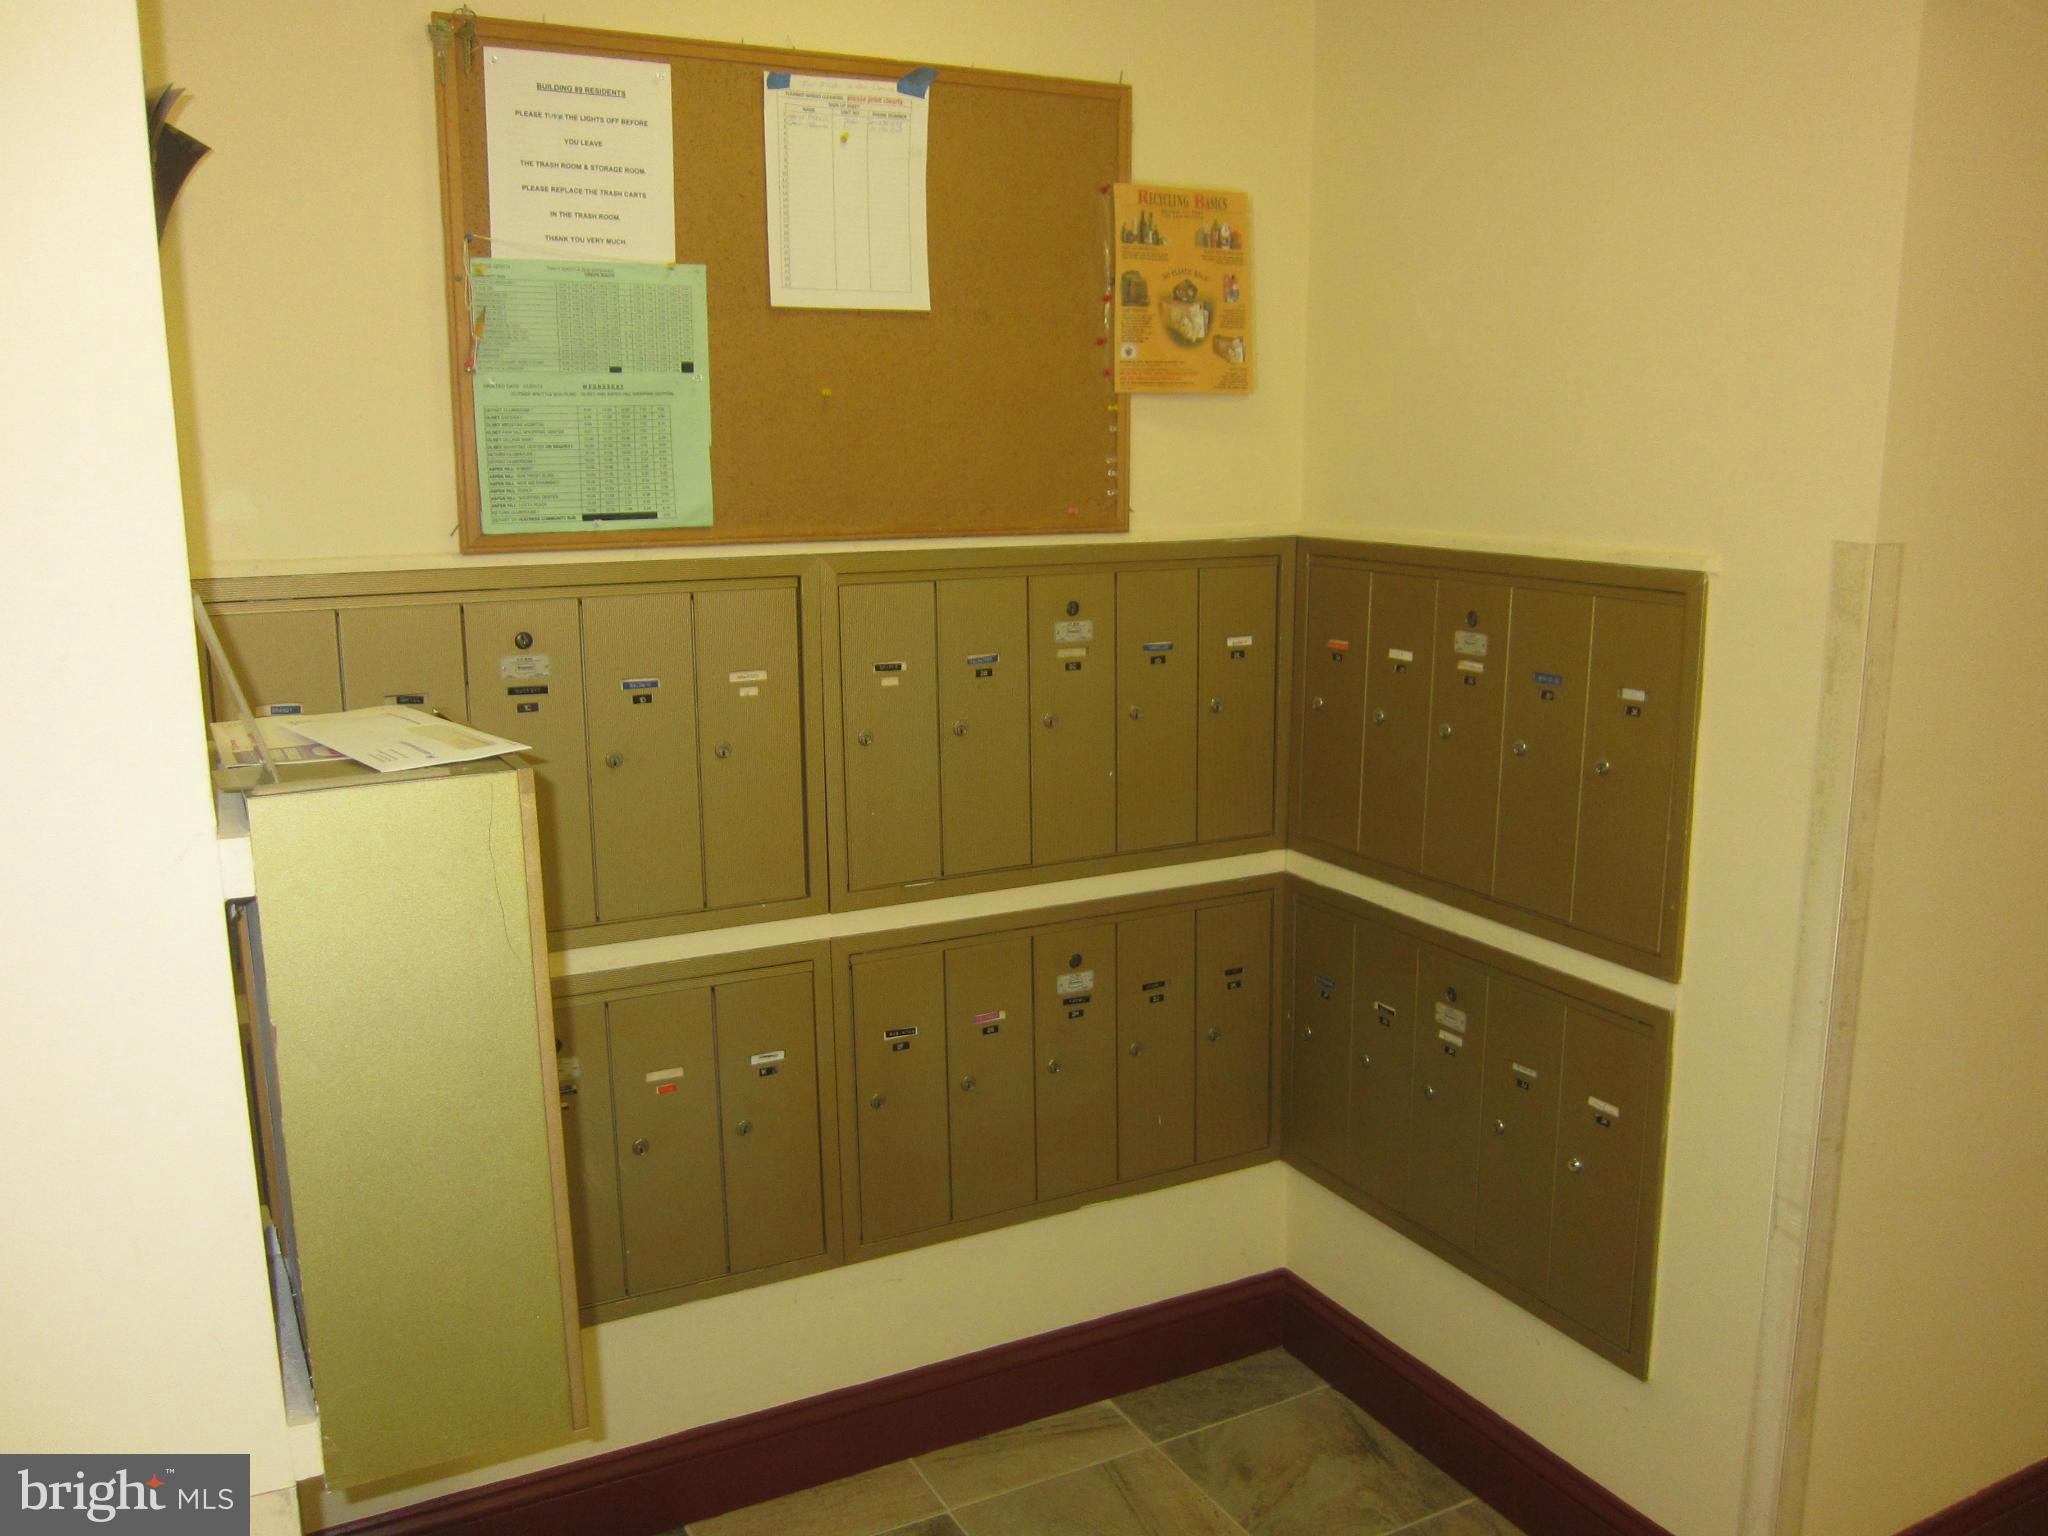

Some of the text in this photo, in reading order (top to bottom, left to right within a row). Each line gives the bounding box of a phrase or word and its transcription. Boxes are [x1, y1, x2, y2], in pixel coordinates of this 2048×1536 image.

[536, 82, 573, 93] BUILDING
[584, 87, 626, 99] RESIDENTS
[515, 109, 543, 119] PLEASE
[565, 113, 579, 121] THE
[580, 115, 605, 124] LIGHTS
[606, 117, 619, 125] OFF
[621, 118, 649, 127] BEFORE
[564, 136, 603, 147] YOU LEAVE
[520, 159, 536, 168] THE
[537, 160, 559, 170] TRASH
[561, 162, 582, 171] ROOM
[584, 163, 589, 171] &
[590, 164, 623, 173] STORAGE
[522, 184, 647, 199] PLEASE REPLACE THE TRASH CARTS
[1138, 189, 1228, 210] RECYCLING BASICS
[550, 209, 557, 218] IN
[559, 210, 572, 219] THE
[574, 211, 597, 220] TRASH
[545, 234, 569, 243] THANK
[570, 235, 585, 244] YOU
[586, 236, 605, 245] VERY
[582, 383, 624, 391] WEDNESDAY
